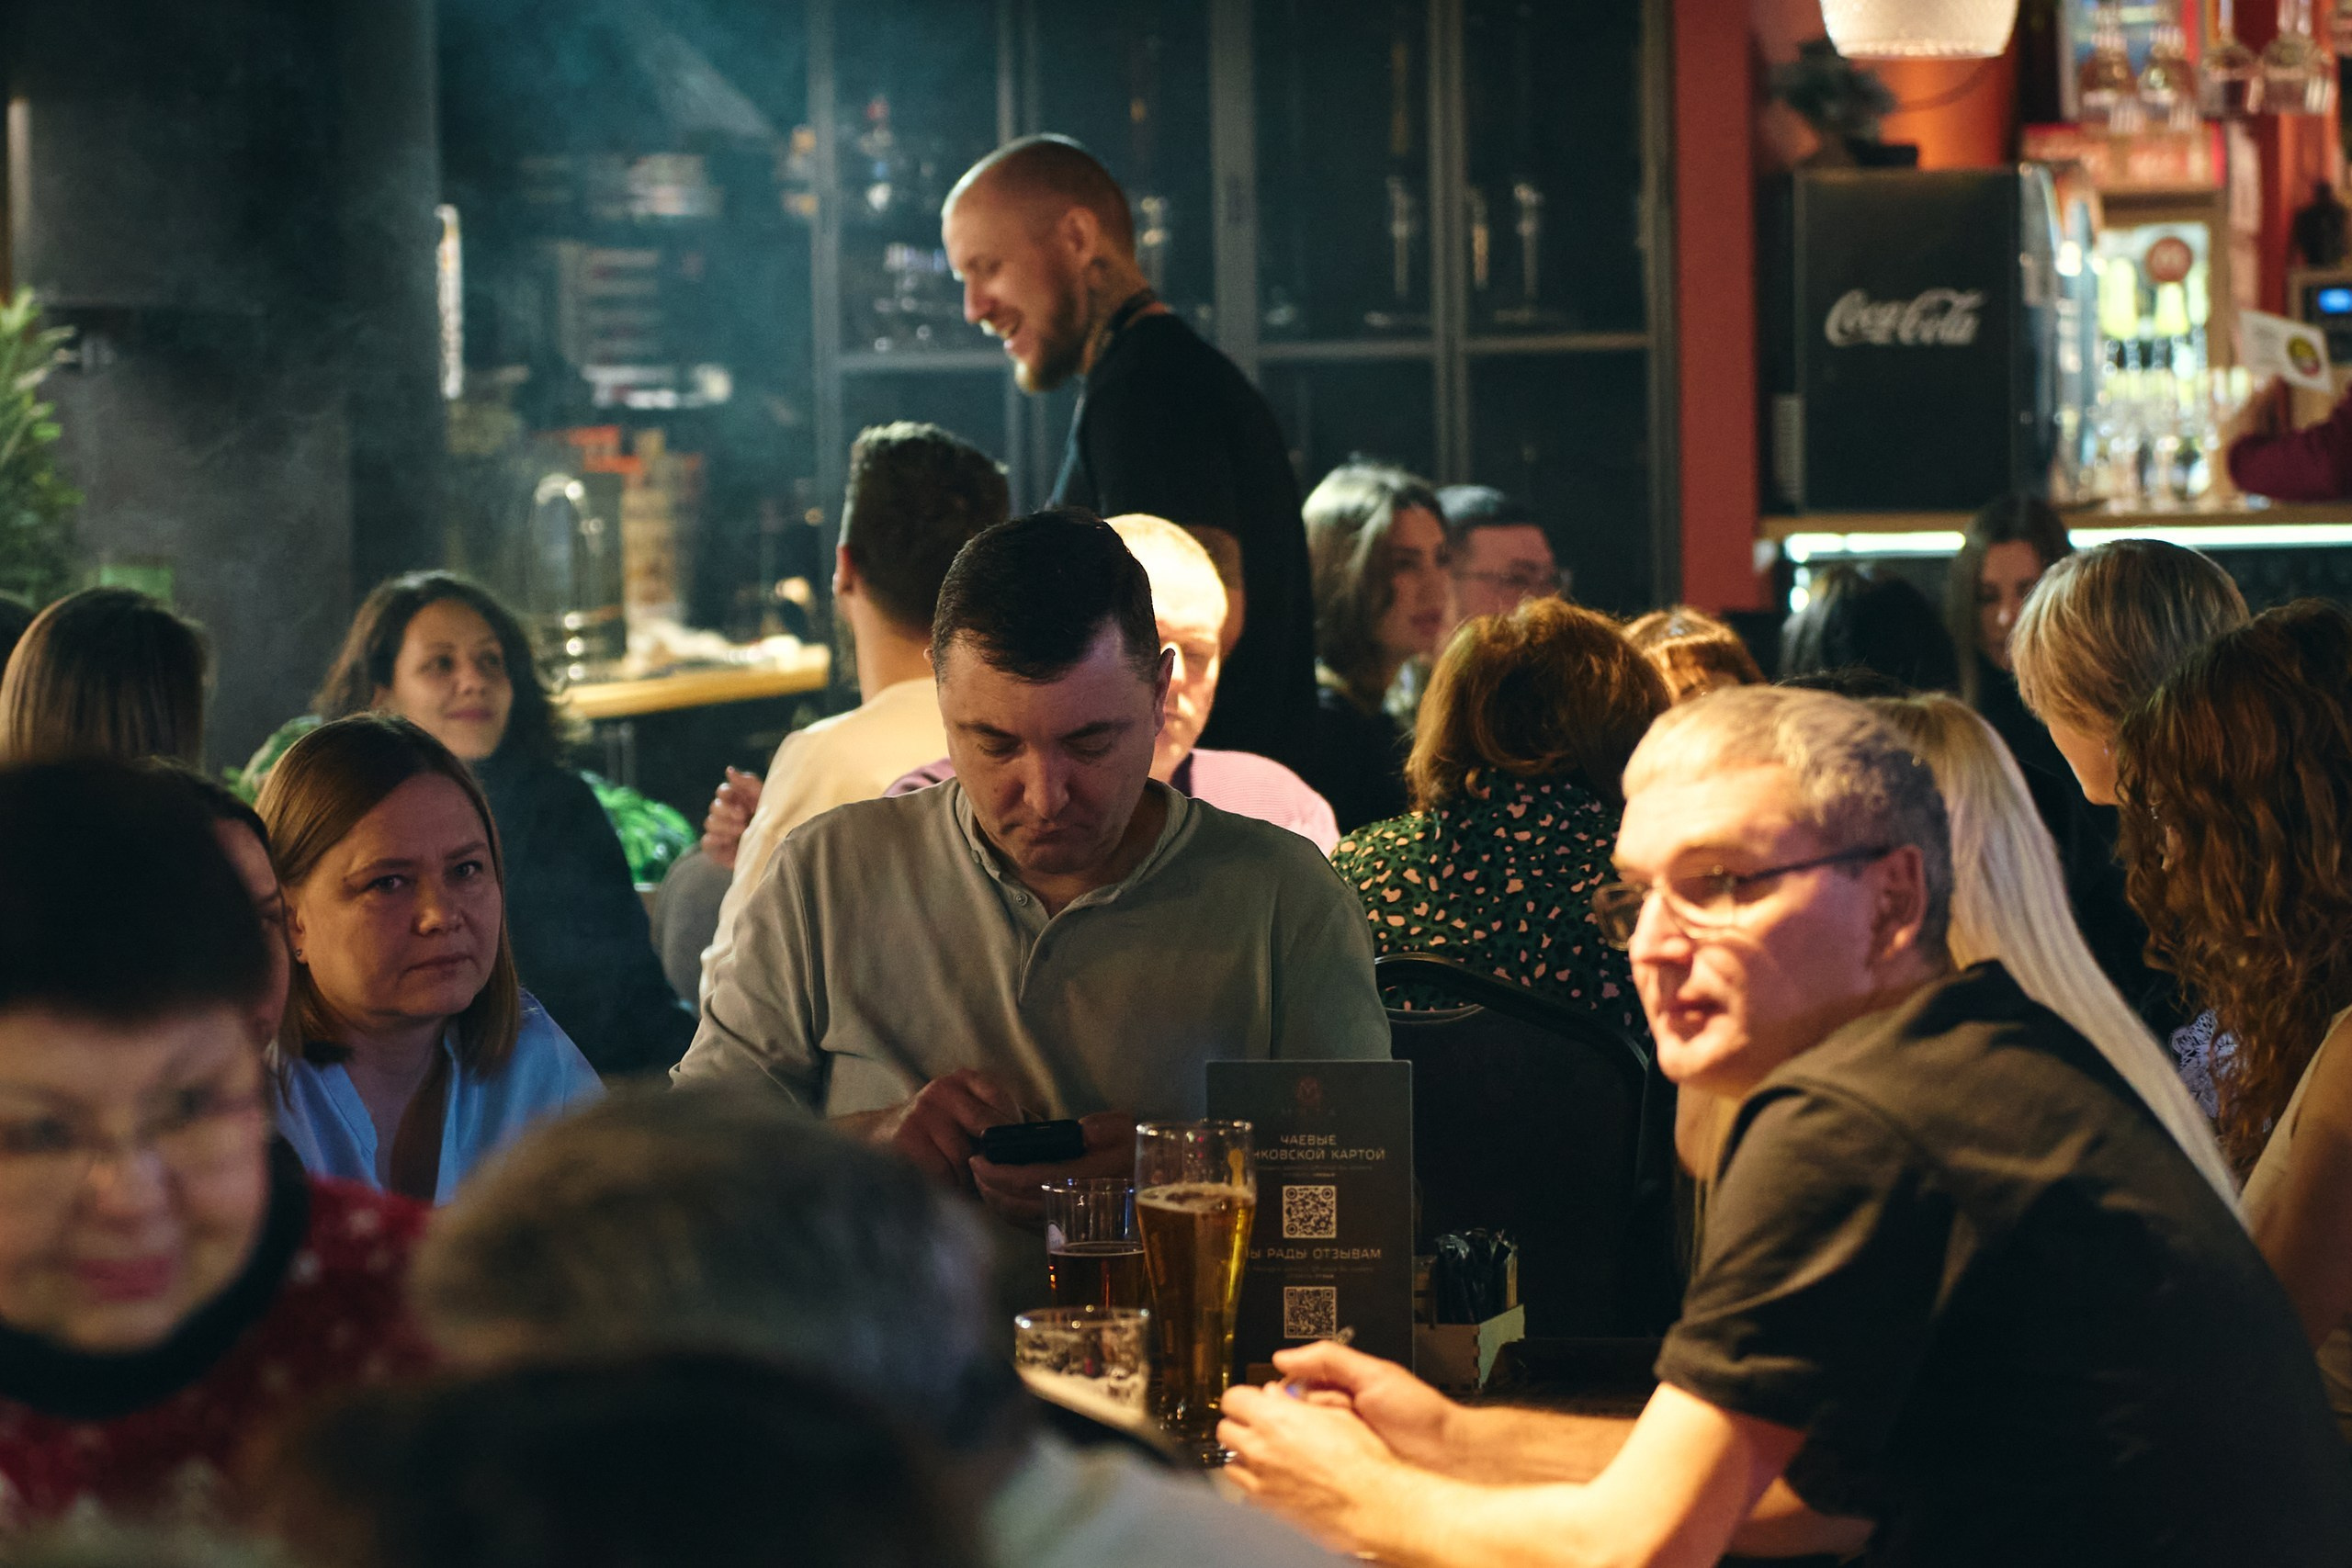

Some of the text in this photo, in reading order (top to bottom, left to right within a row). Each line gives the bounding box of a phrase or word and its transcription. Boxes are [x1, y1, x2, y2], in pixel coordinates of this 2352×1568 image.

[1280, 1134, 1337, 1145] ЧАЕВЫЕ
[1253, 1148, 1385, 1161] НКОВСКОЙ КАРТОЙ
[1246, 1247, 1382, 1259] Ы РАДЫ ОТЗЫВАМ
